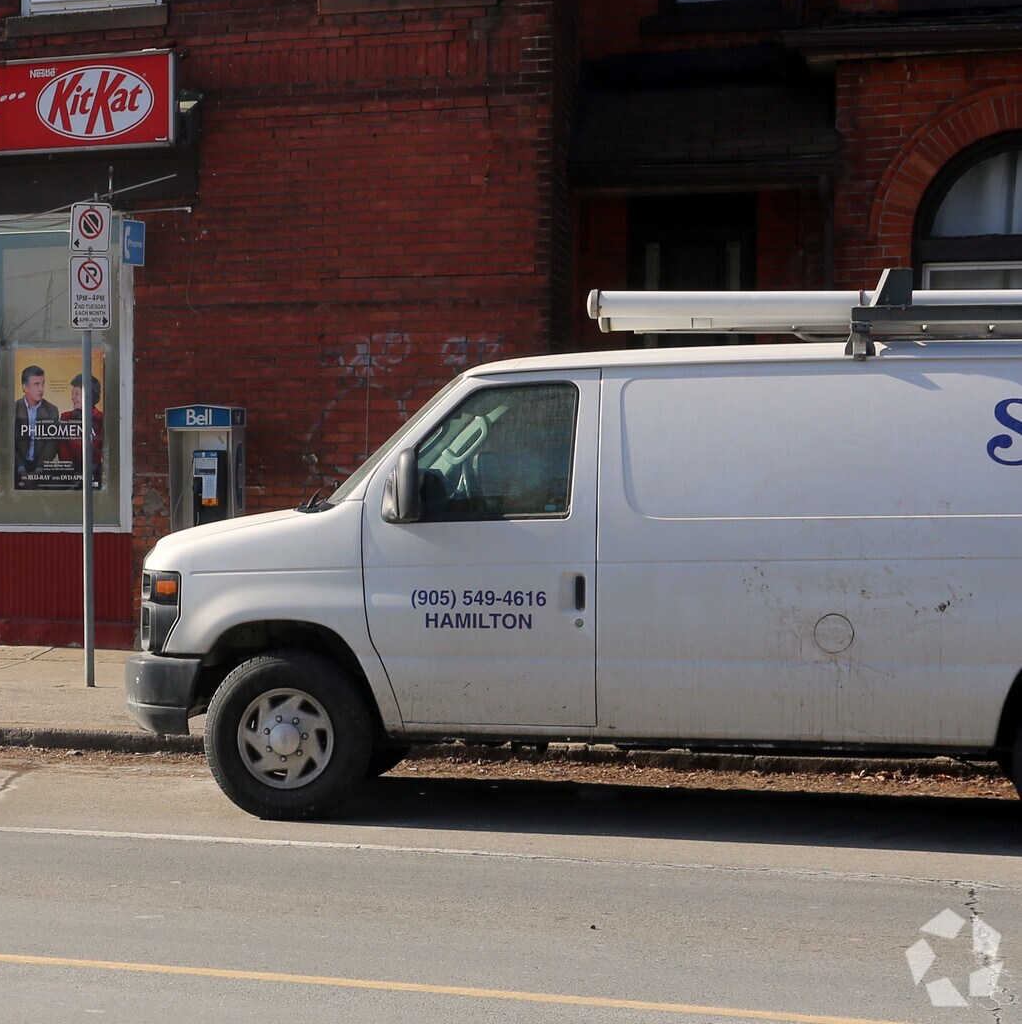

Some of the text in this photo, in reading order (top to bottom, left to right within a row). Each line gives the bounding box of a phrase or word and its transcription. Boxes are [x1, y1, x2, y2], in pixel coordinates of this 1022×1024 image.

[47, 71, 144, 134] KitKat
[127, 238, 143, 249] Phone
[186, 409, 212, 425] Bell
[411, 590, 547, 609] (905) 549-4616
[425, 613, 532, 629] HAMILTON
